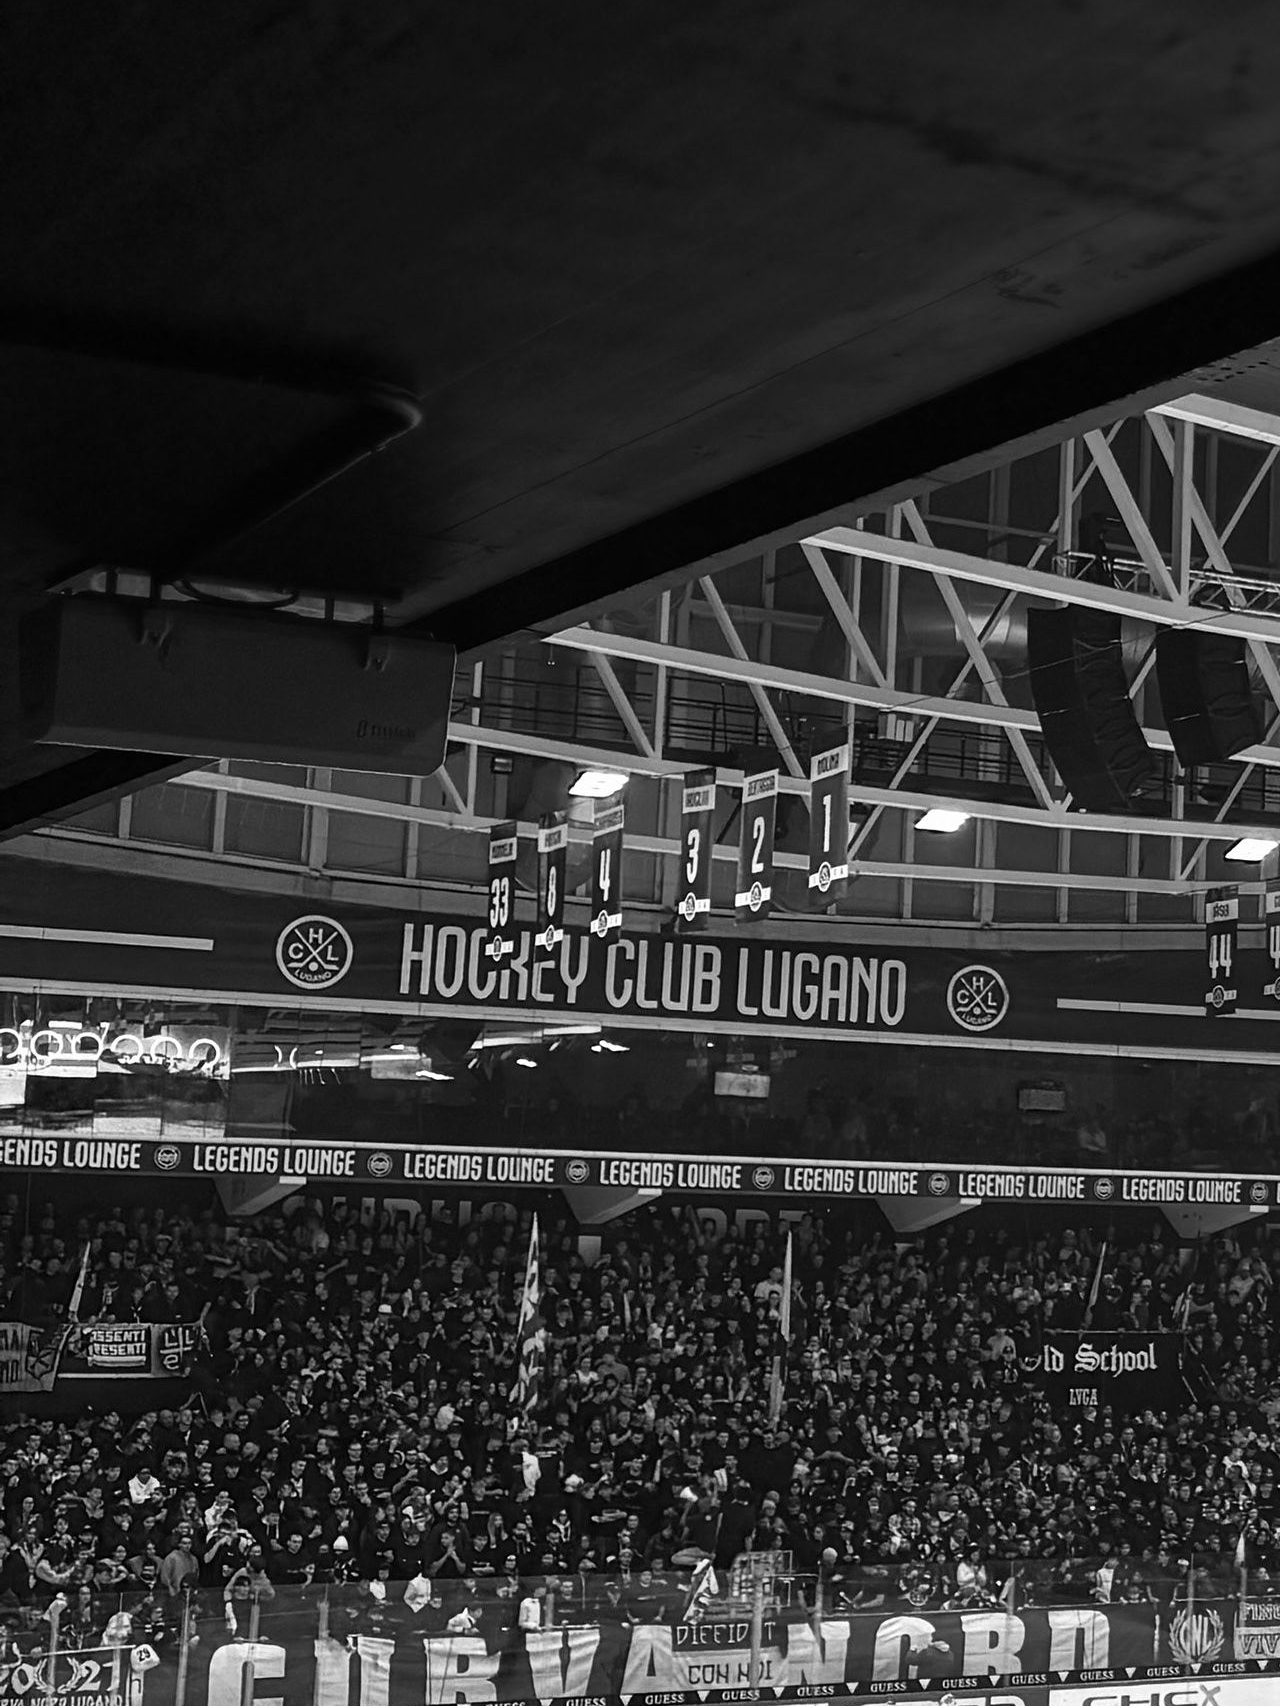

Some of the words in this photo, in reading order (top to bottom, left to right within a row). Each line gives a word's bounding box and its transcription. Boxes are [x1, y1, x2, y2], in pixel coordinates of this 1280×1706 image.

[822, 795, 832, 852] 1
[686, 829, 700, 883] 3
[752, 817, 765, 873] 2
[547, 866, 557, 916] 8
[600, 849, 611, 901] 4
[489, 877, 509, 928] 33
[1210, 934, 1231, 978] 44
[400, 923, 589, 1004] HOCKEY
[606, 938, 722, 1013] CLUB
[737, 946, 907, 1026] LUGANO
[0, 1139, 57, 1167] ENDS
[64, 1143, 141, 1169] LOUNGE
[193, 1145, 278, 1173] LEGENDS
[284, 1149, 356, 1176] LOUNGE
[404, 1153, 482, 1181] LEGENDS
[487, 1157, 554, 1183] LOUNGE
[600, 1160, 673, 1186] LEGENDS
[678, 1163, 742, 1189] LOUNGE
[785, 1167, 854, 1192] LEGENDS
[858, 1170, 918, 1194] LOUNGE
[960, 1173, 1024, 1197] LEGENDS
[1028, 1175, 1084, 1199] LOUNGE
[1122, 1177, 1184, 1202] LEGENDS
[1188, 1180, 1241, 1204] LOUNGE
[1074, 1343, 1158, 1378] School
[870, 1681, 906, 1692] GUESS
[1147, 1666, 1180, 1677] GUESS
